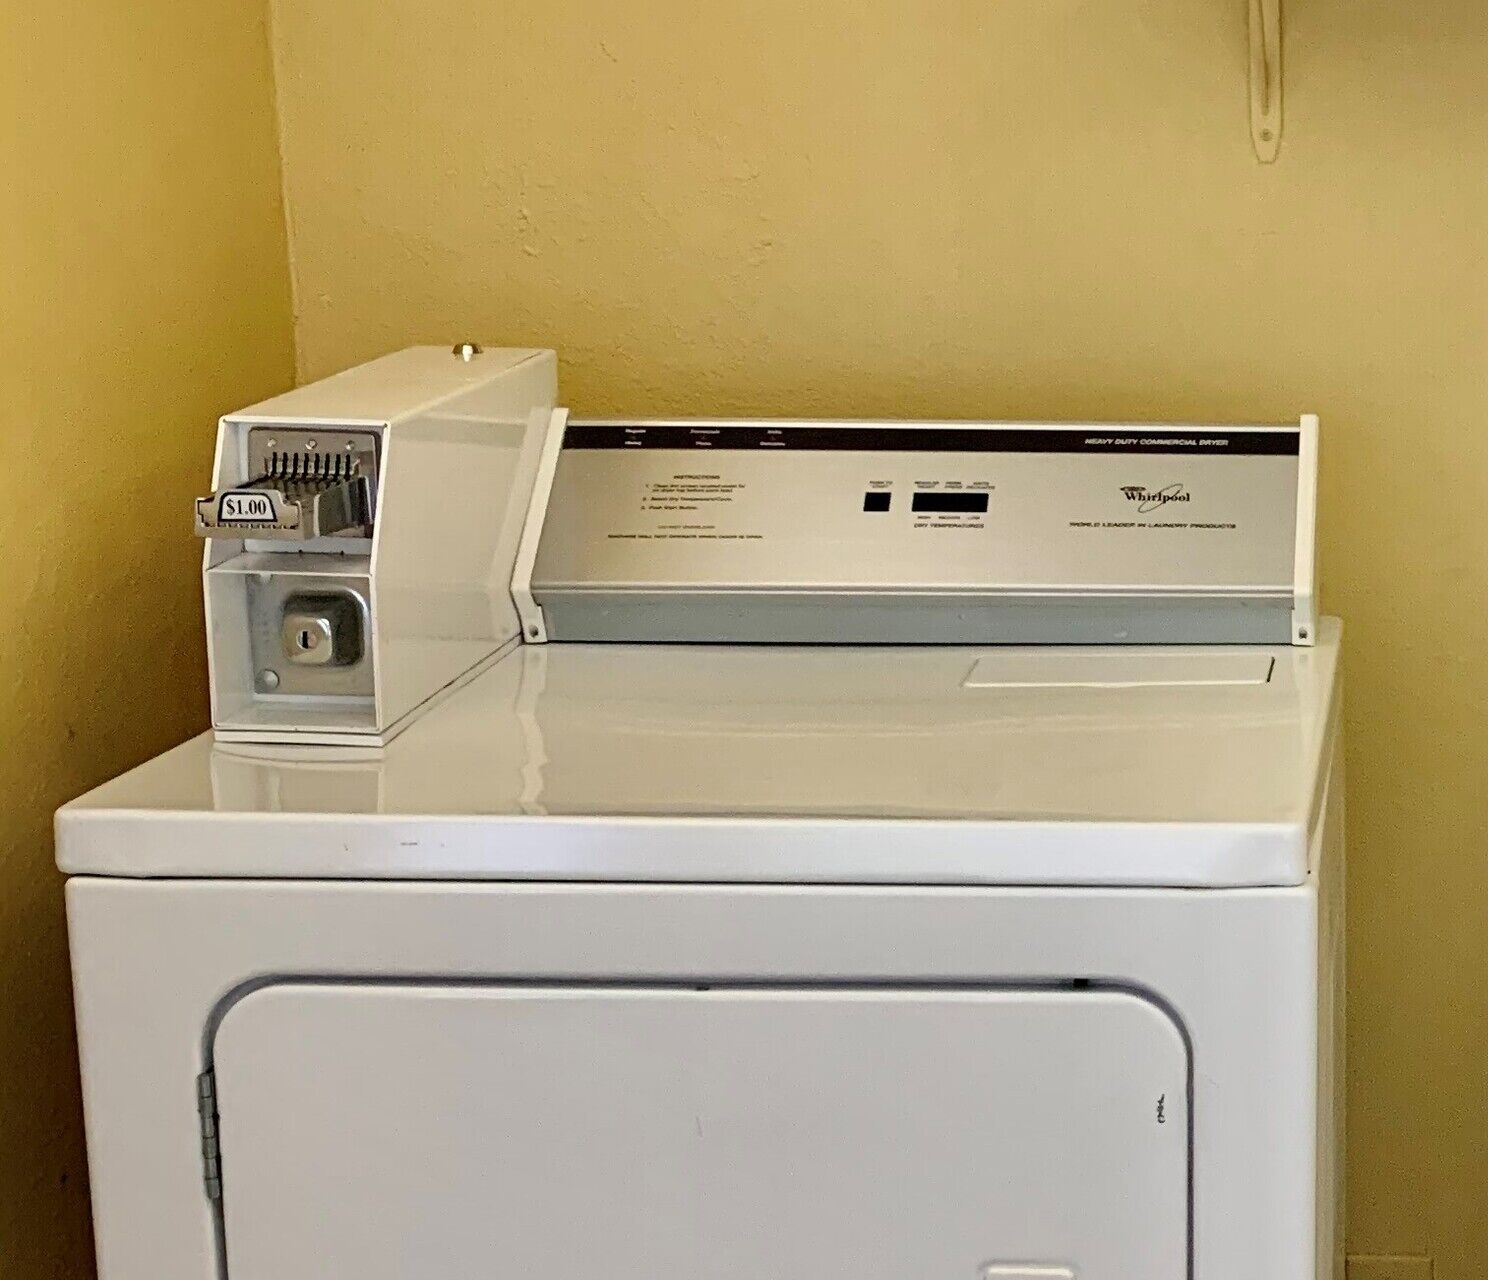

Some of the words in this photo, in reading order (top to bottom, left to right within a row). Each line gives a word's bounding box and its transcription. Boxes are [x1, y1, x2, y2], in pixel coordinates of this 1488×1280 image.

[1084, 438, 1114, 446] HEAVY
[1115, 438, 1138, 446] DUTY
[1139, 438, 1197, 447] COMMERCIAL
[1198, 439, 1229, 447] DRYER
[1123, 491, 1191, 504] Whirlpool
[226, 498, 266, 516] $1.00
